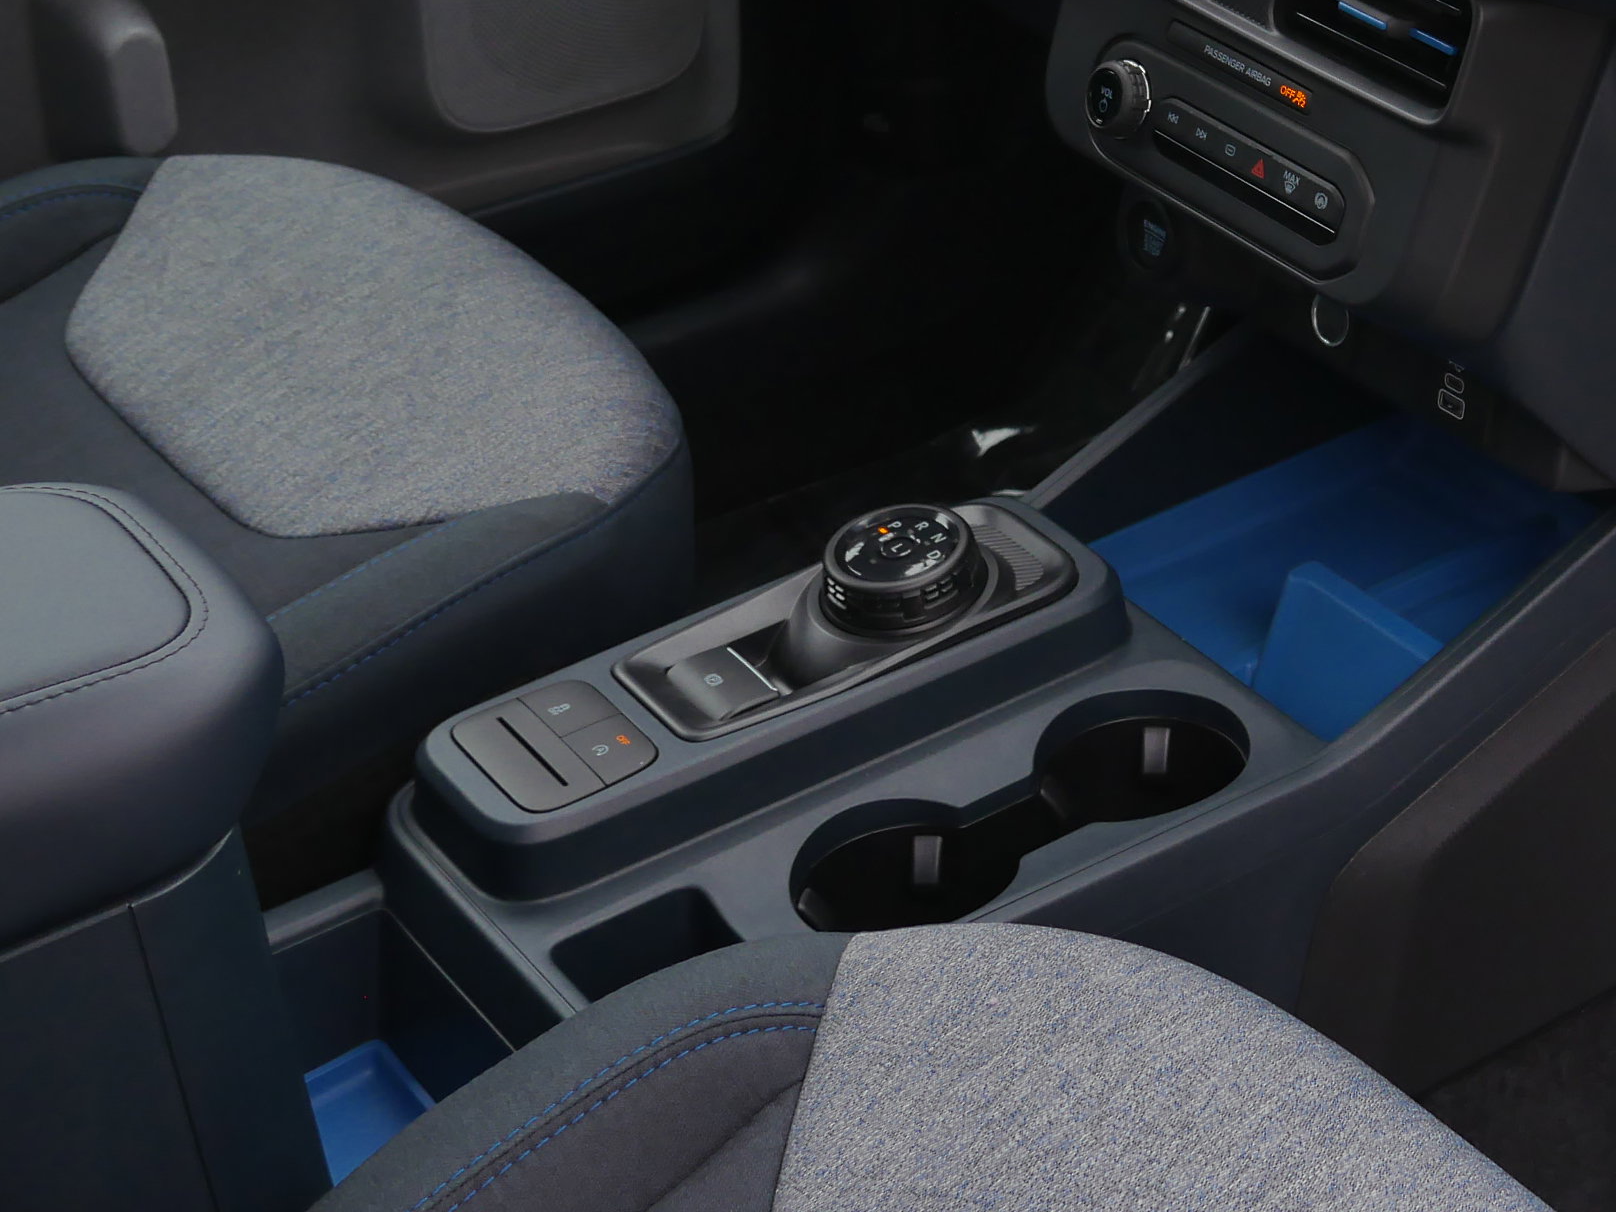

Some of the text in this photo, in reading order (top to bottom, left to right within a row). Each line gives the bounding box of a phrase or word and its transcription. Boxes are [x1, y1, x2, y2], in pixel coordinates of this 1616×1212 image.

[1204, 44, 1296, 99] PASSENGER AIRBAG OFF
[1101, 87, 1113, 100] VOL
[1283, 170, 1301, 186] MAX
[887, 520, 902, 528] P
[915, 521, 929, 531] R
[930, 532, 947, 543] N
[890, 543, 903, 553] L
[926, 549, 941, 560] D
